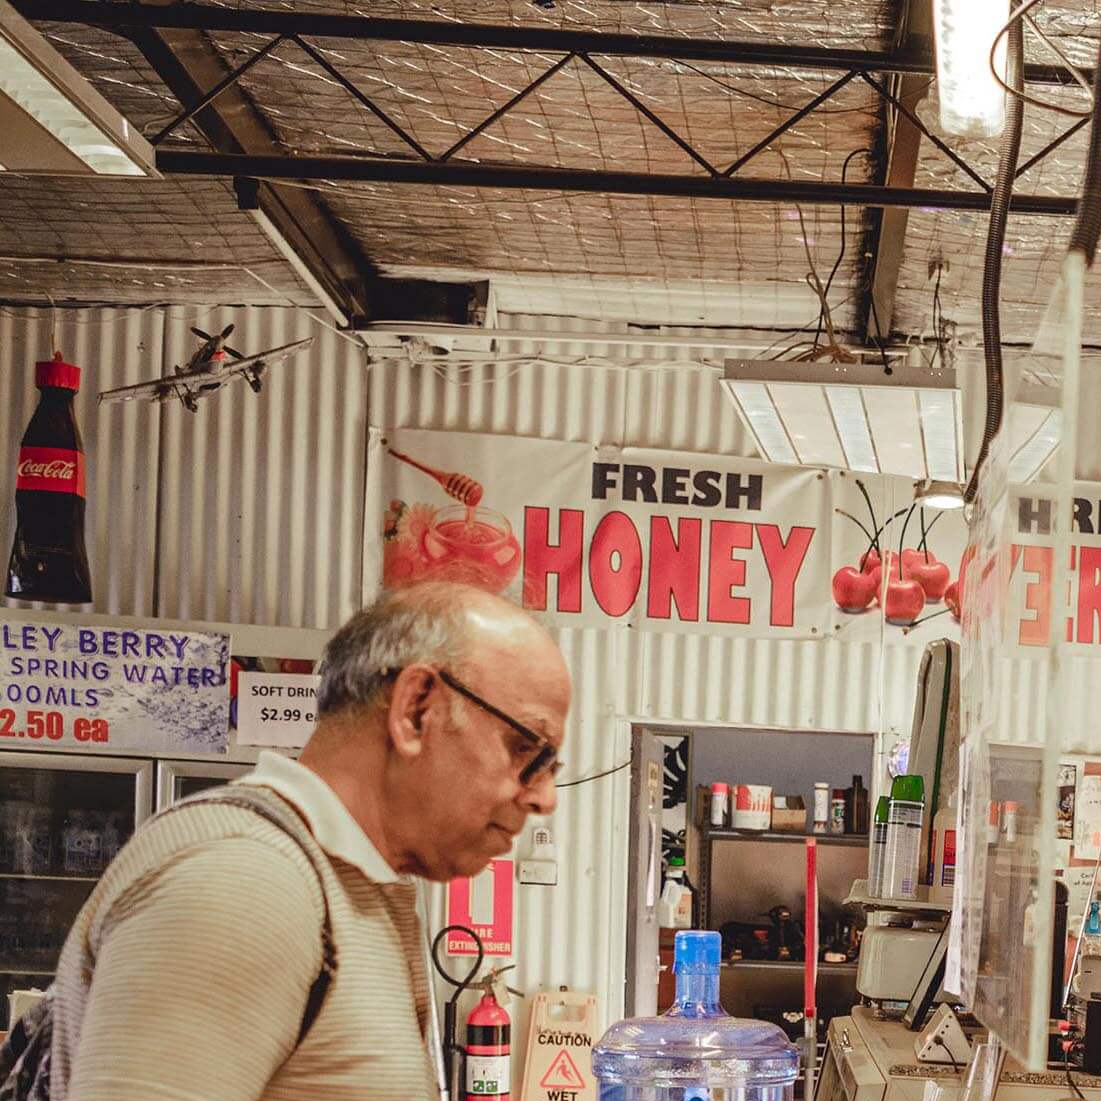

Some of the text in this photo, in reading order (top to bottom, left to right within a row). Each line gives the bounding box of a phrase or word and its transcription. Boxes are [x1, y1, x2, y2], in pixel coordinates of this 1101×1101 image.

[592, 462, 763, 511] FRESH
[522, 505, 816, 627] HONEY
[78, 629, 189, 658] BERRY
[10, 656, 216, 688] SPRING WATER
[0, 683, 99, 707] 00MLS
[251, 685, 317, 698] SOFT DRIN
[0, 708, 110, 743] 2.50 ea
[260, 707, 301, 722] $2.99
[469, 928, 495, 938] IRE
[538, 1034, 592, 1047] CAUTION
[547, 1091, 578, 1101] WET
